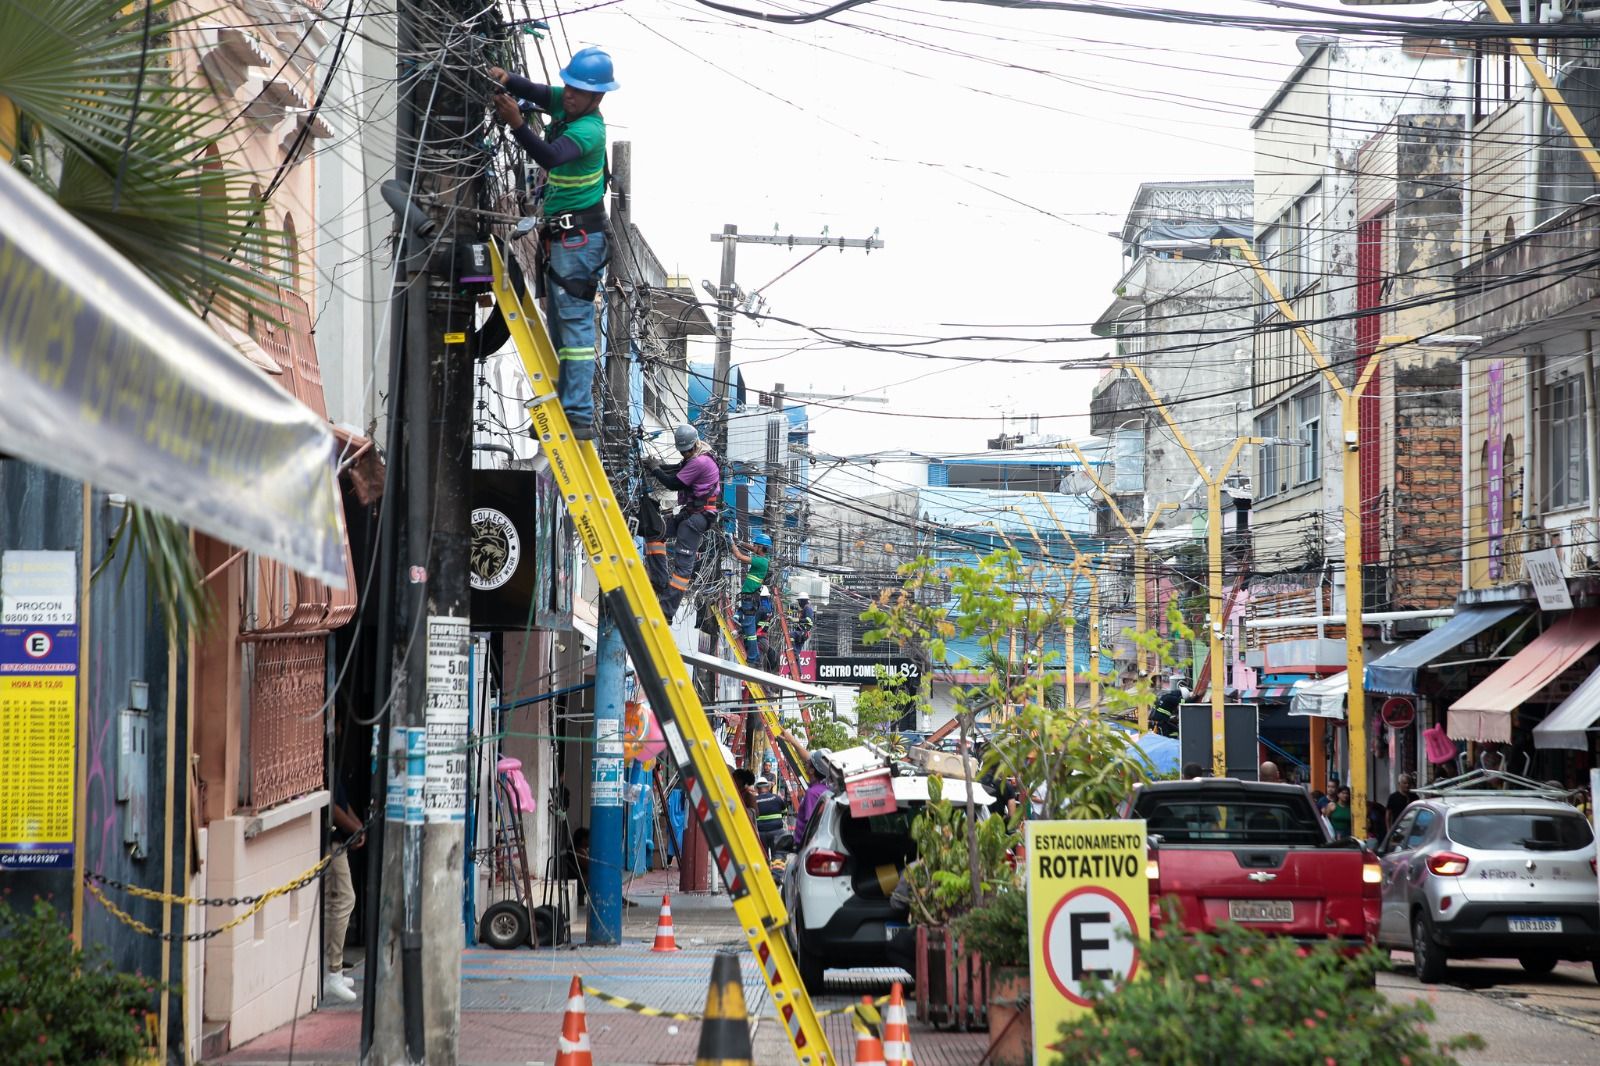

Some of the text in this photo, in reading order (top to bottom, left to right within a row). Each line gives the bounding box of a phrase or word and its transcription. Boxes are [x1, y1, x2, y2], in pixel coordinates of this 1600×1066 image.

[532, 404, 550, 434] 6,00m
[551, 448, 571, 485] ondacom
[472, 511, 515, 540] COLLECTION
[480, 575, 503, 586] STREET
[504, 556, 516, 575] WEAR
[16, 602, 62, 611] PROCON
[5, 613, 72, 622] 0800 92 15 12
[31, 637, 44, 652] E
[820, 664, 851, 677] CENTRO
[852, 664, 897, 677] COMEIAL
[900, 663, 919, 678] 82
[11, 681, 31, 689] HORA
[45, 681, 64, 689] 12,00
[1035, 834, 1141, 850] ESTACIONAMENTO
[1, 855, 17, 863] Cel.
[1038, 854, 1139, 879] ROTATIVO
[1489, 869, 1517, 879] Fibra
[1069, 911, 1114, 982] E
